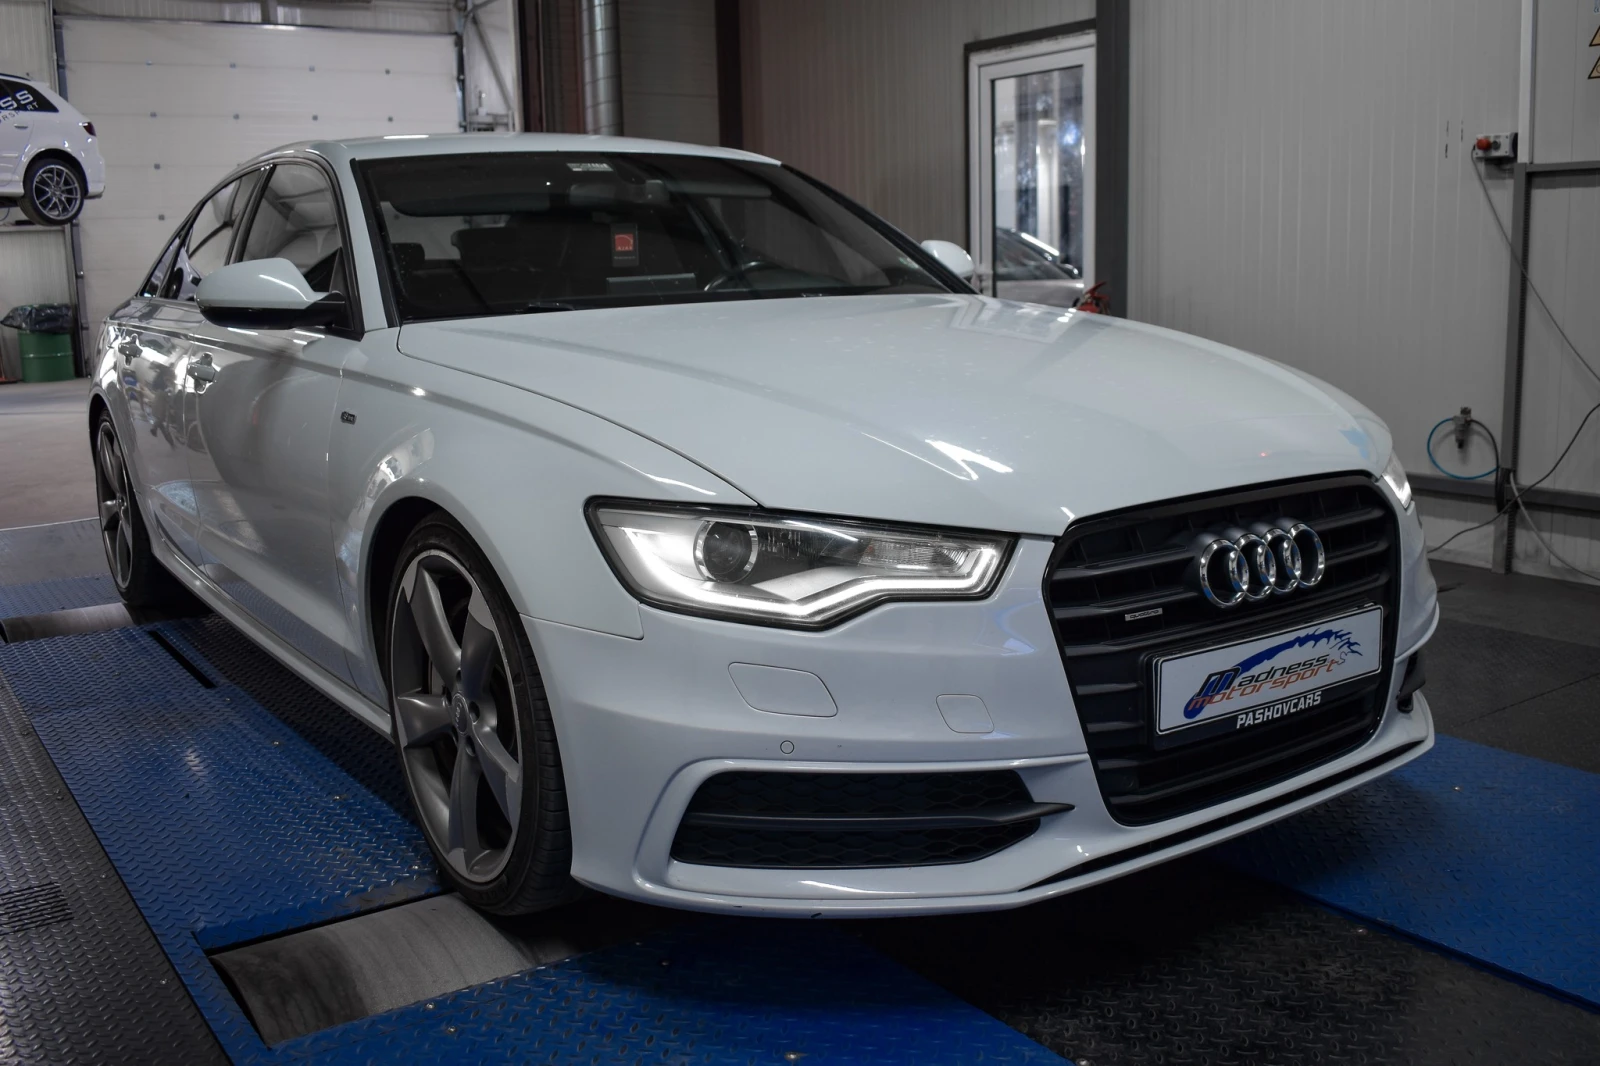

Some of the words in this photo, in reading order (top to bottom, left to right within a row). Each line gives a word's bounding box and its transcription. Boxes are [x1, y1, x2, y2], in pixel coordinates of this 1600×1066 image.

[1129, 609, 1160, 620] quattro
[1187, 658, 1338, 711] motorsport
[1197, 654, 1330, 698] Madness
[1236, 691, 1322, 729] PASHOVCARS
